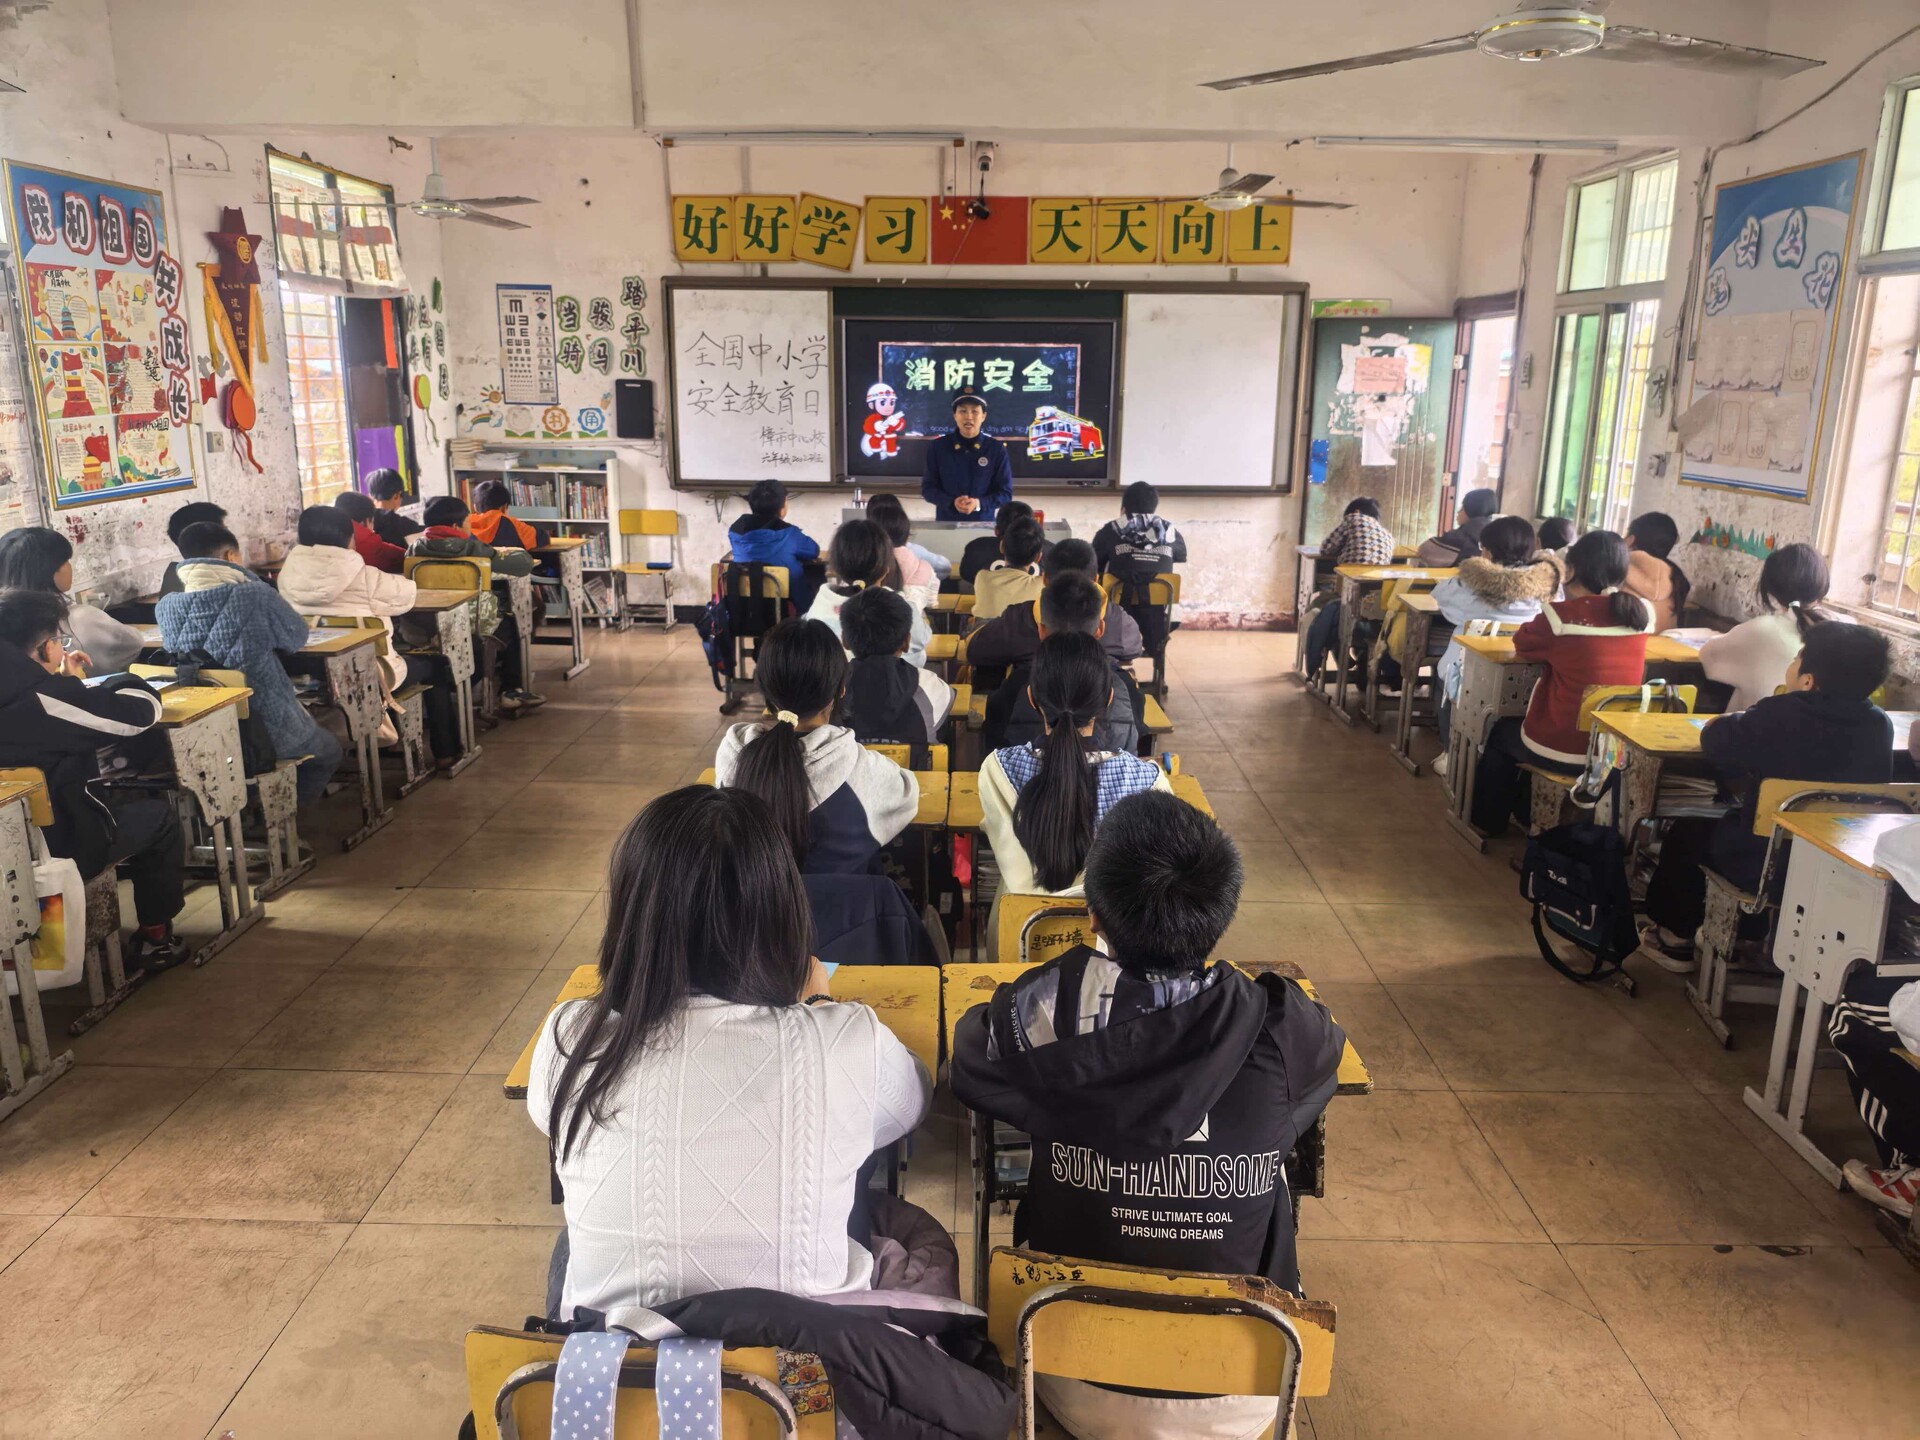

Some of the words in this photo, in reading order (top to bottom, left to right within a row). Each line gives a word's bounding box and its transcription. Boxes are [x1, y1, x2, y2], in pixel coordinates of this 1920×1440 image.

[25, 193, 154, 259] 我和祖国
[678, 203, 916, 256] 好好学习
[1036, 203, 1281, 256] 天天向上
[156, 260, 188, 420] 共成长
[560, 301, 582, 369] 当骑
[590, 300, 612, 374] 骏马
[624, 280, 646, 373] 踏平川
[685, 331, 828, 380] 全国中小学
[904, 357, 1055, 393] 消防安全
[687, 379, 820, 425] 安全教育日
[1051, 1142, 1280, 1199] SUN-HANDSOME
[1111, 1206, 1149, 1221] STRIVE
[1151, 1209, 1203, 1223] ULTIMATE
[1206, 1211, 1233, 1223] GOAL
[1121, 1224, 1177, 1239] PURSUING
[1180, 1228, 1224, 1240] DREAMS
